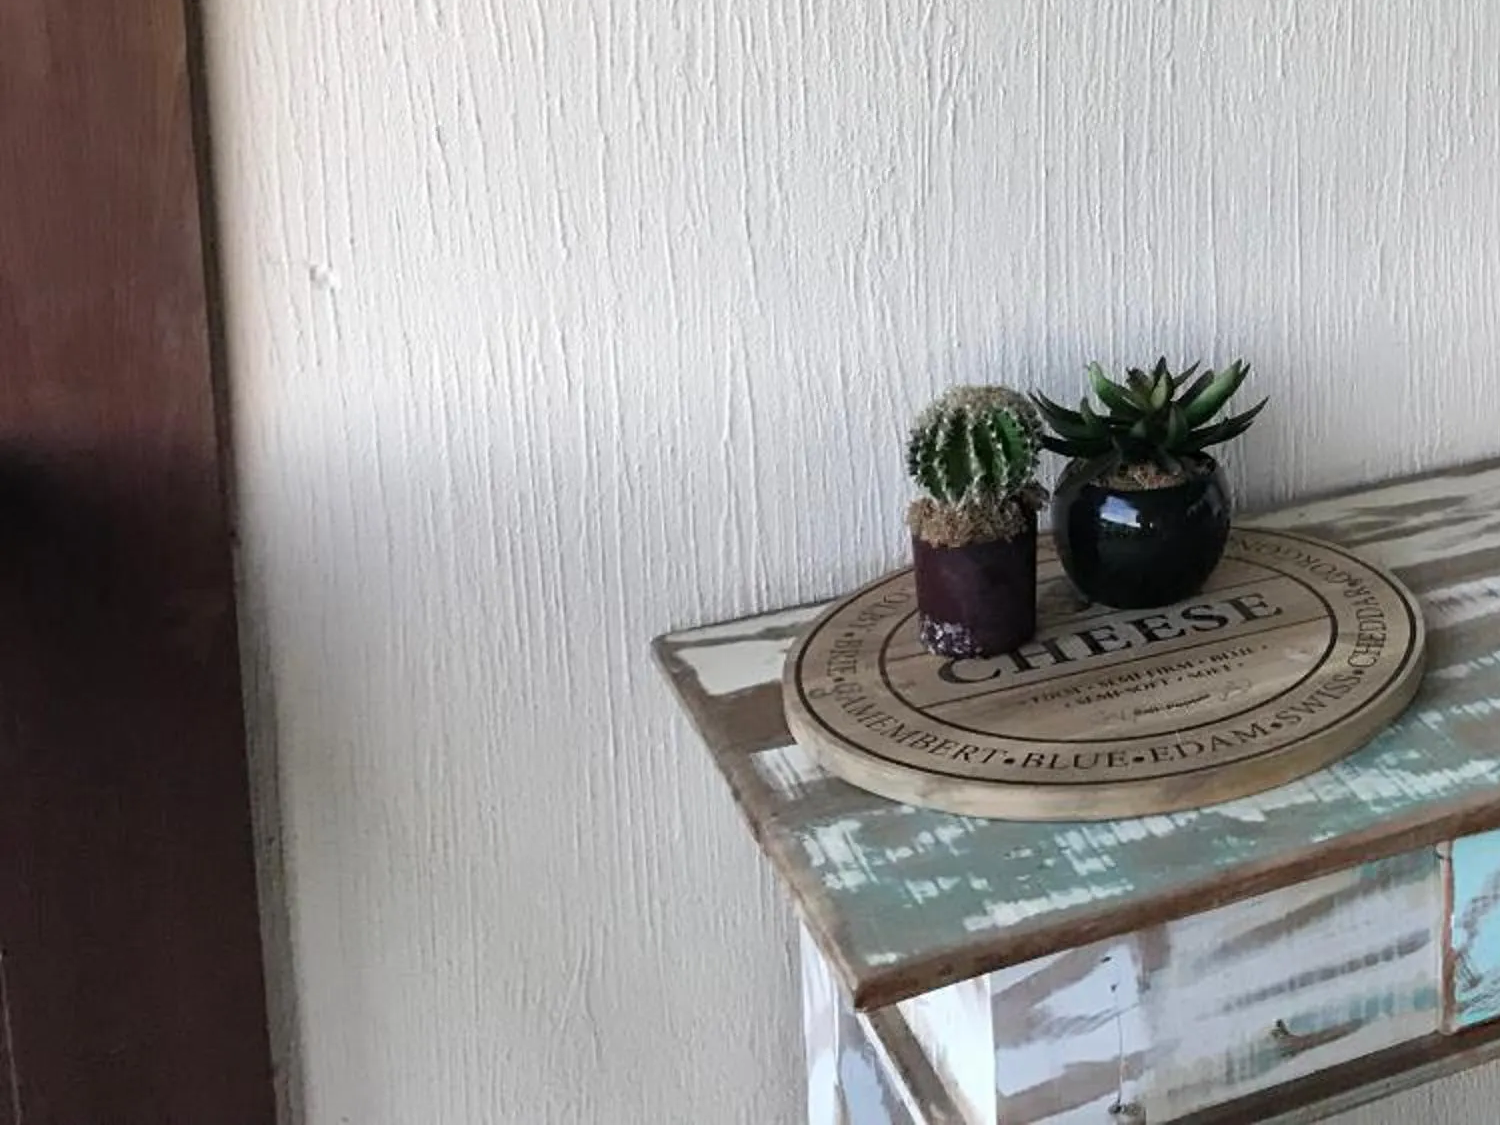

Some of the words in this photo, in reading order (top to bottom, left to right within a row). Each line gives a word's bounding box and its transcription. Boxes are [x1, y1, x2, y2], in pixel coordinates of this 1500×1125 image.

[1229, 537, 1349, 585] GORGON
[848, 589, 912, 633] OLBY
[1343, 585, 1388, 668] CHEDDAR
[826, 639, 863, 677] BRIE
[937, 591, 1283, 684] CHEESE
[833, 682, 1004, 764] CAMEMBERT
[1276, 674, 1361, 725] SWISS
[1021, 750, 1128, 770] BLUE
[1151, 721, 1268, 763] EDAM
